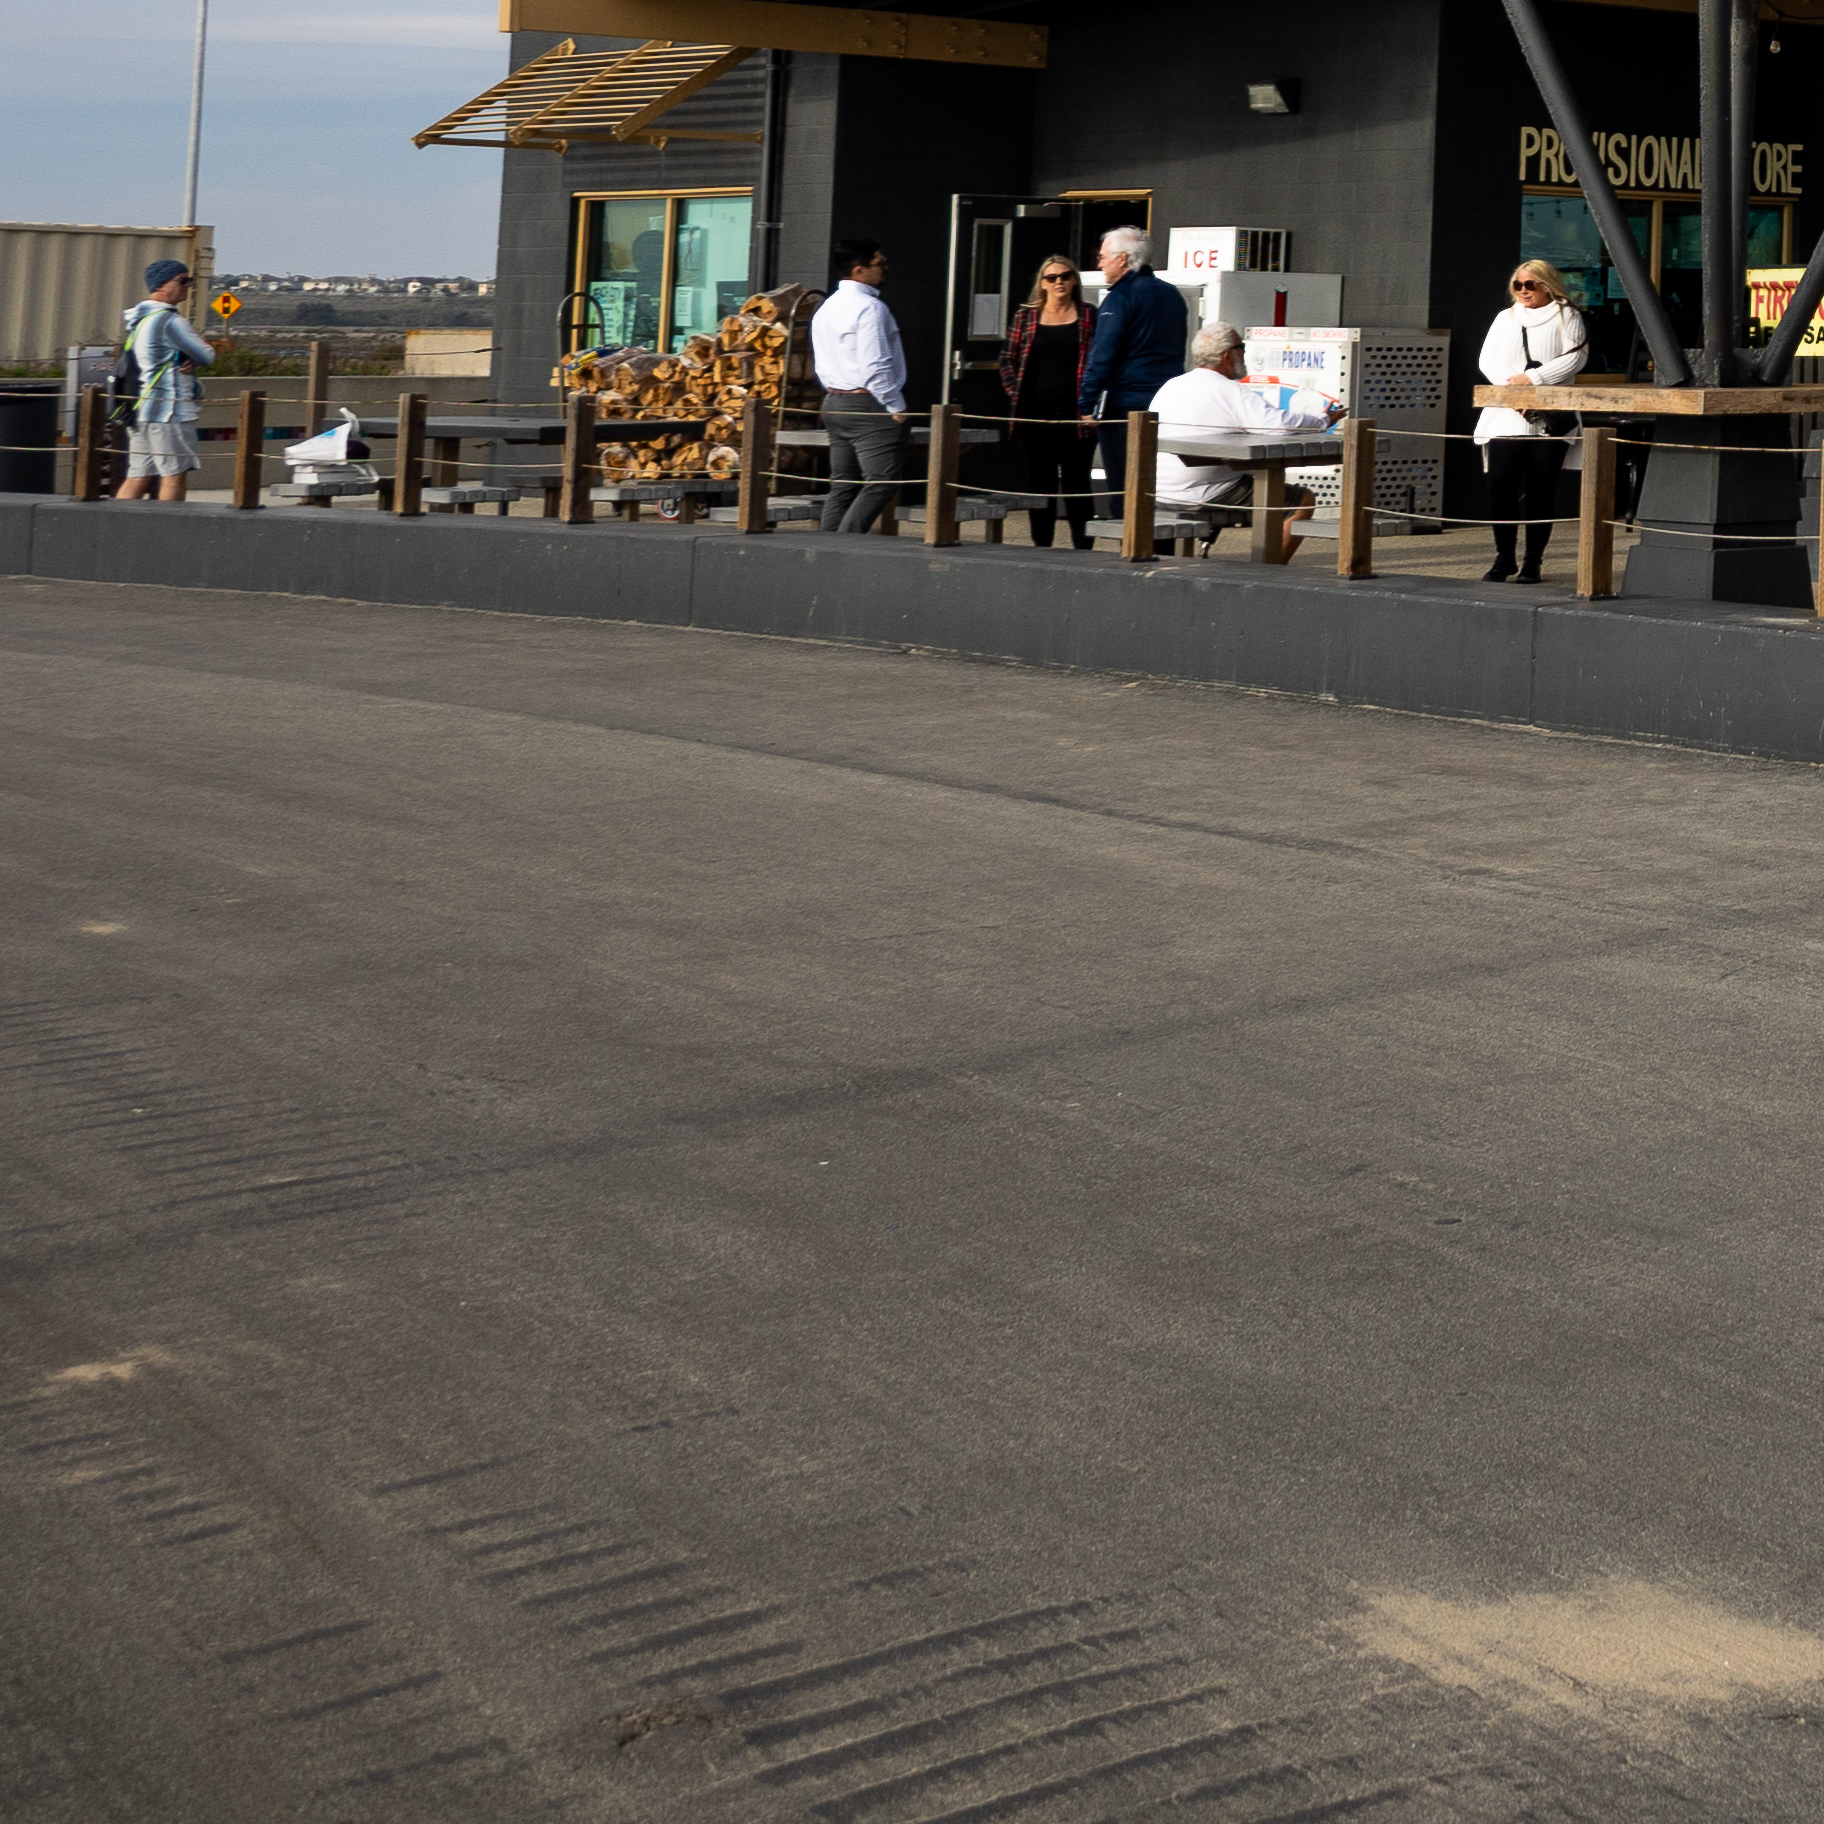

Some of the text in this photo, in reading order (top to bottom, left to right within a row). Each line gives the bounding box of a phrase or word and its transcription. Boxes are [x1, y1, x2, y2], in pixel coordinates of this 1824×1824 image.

[1752, 141, 1803, 193] ORE
[1184, 250, 1218, 268] ICE
[1254, 329, 1287, 337] PROPANE
